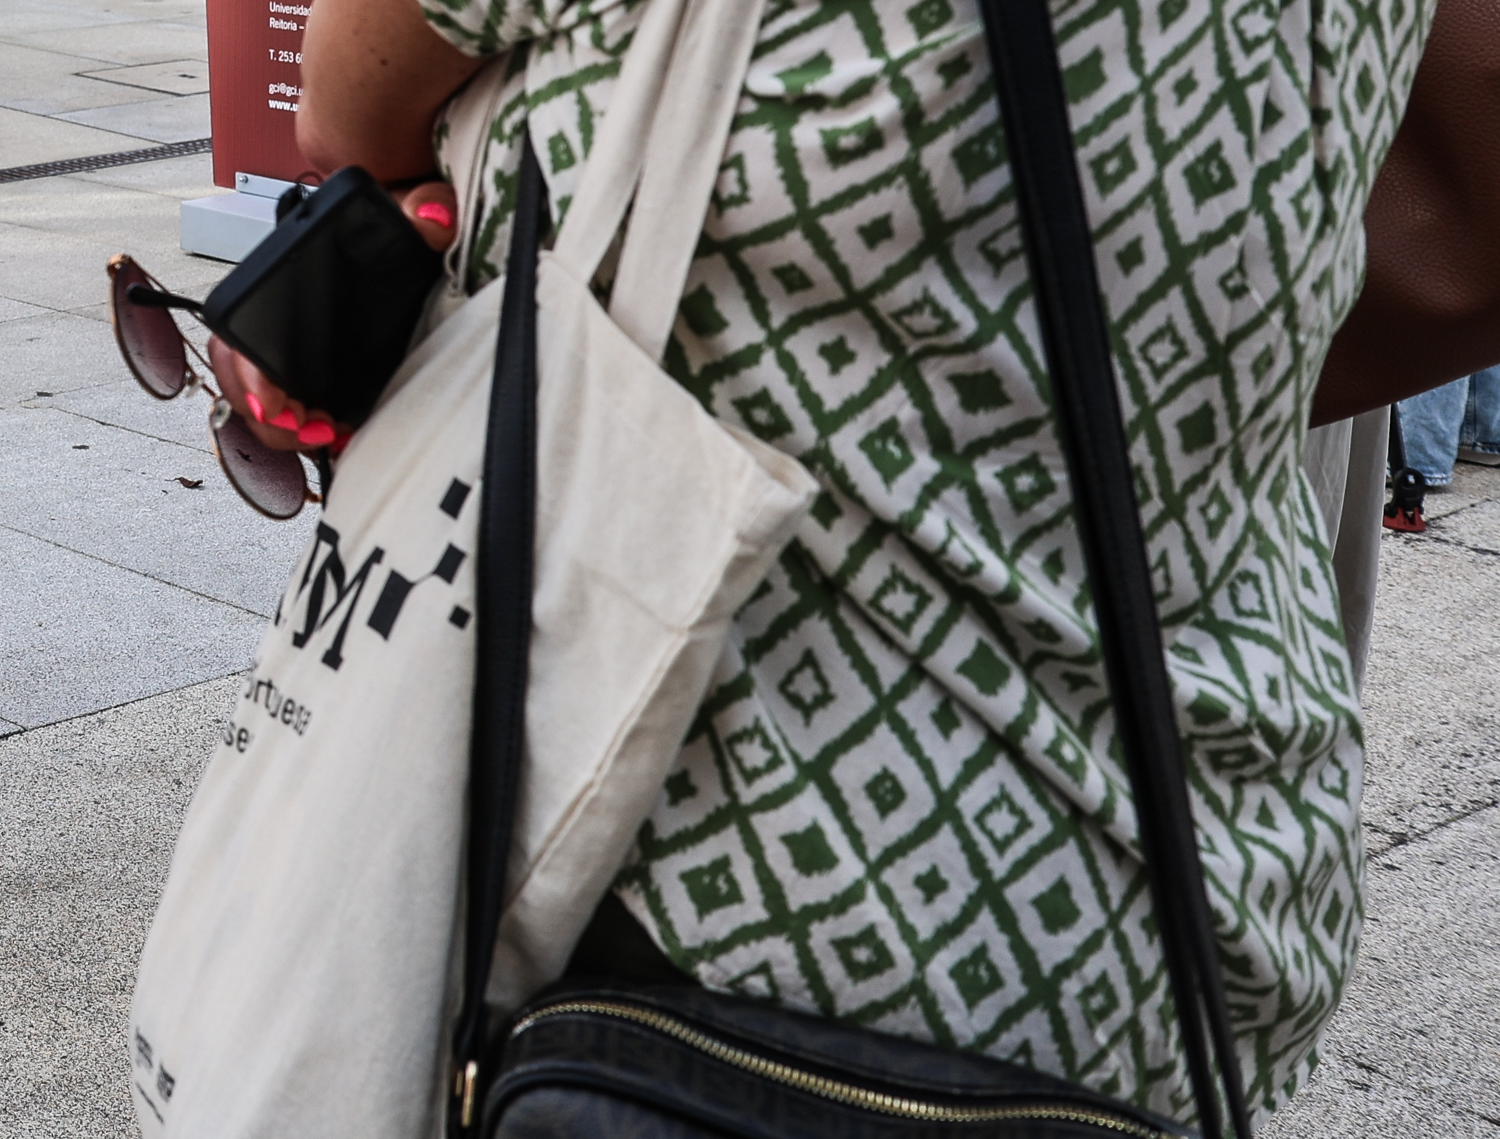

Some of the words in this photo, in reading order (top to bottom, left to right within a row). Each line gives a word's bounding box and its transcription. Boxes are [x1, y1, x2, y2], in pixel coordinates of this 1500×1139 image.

[269, 17, 298, 31] Reitoria
[268, 49, 276, 61] T.
[278, 50, 294, 63] 253
